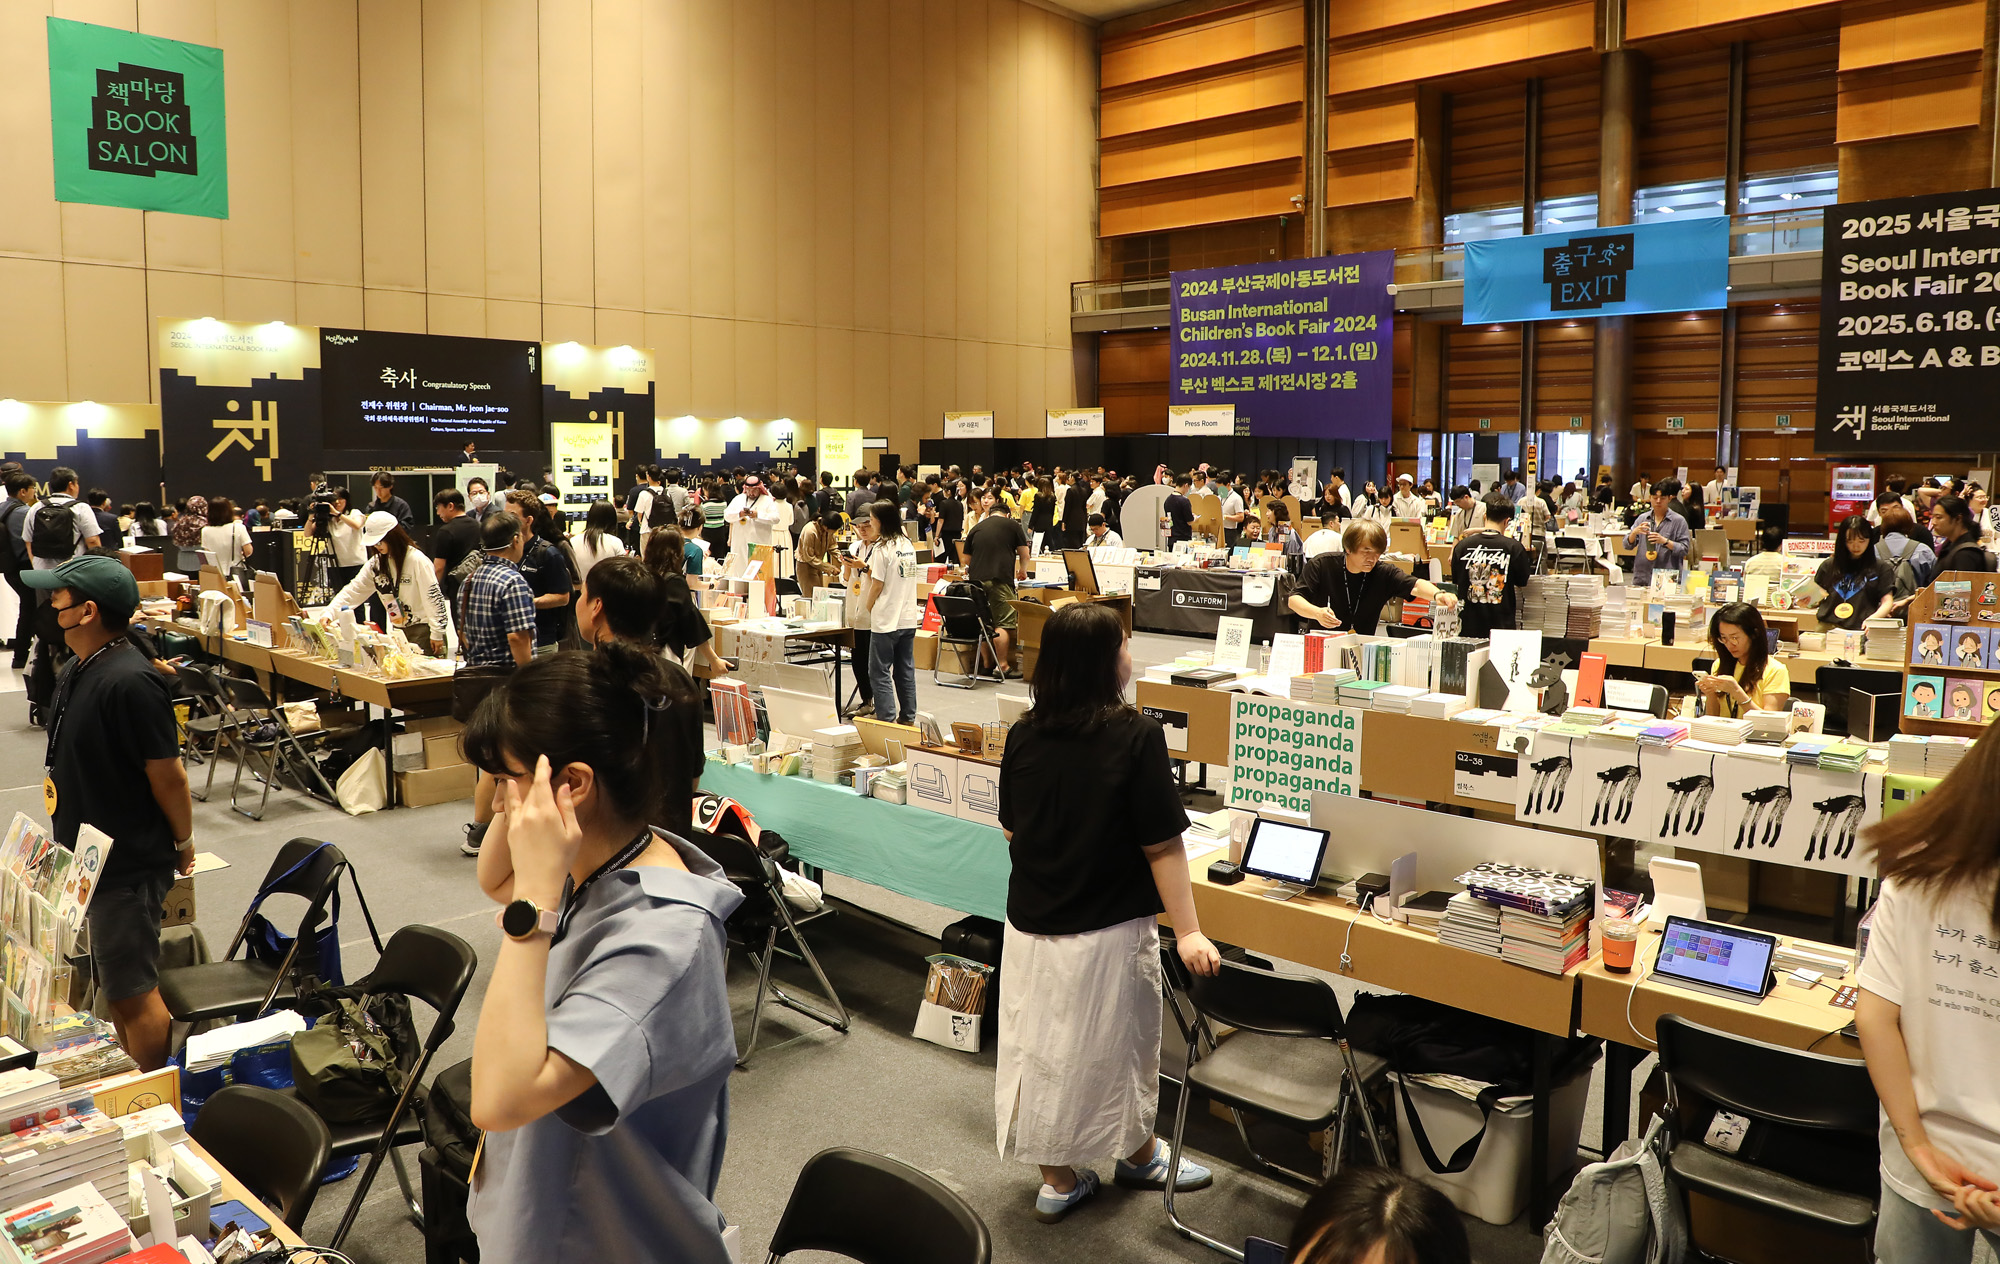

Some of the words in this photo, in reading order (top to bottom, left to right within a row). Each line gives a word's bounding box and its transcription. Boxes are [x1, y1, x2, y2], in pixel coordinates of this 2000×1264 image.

[107, 78, 176, 106] 책마당
[106, 110, 180, 134] BOOK
[98, 141, 188, 166] SALON
[1841, 214, 1911, 239] 2025
[1552, 244, 1596, 276] 출구
[1840, 249, 1916, 274] Seoul
[1180, 280, 1218, 297] 2024
[1221, 264, 1360, 295] 부산국제아동도서전
[1560, 274, 1618, 303] EXIT
[1839, 278, 1908, 301] Book
[1914, 274, 1969, 297] Fair
[1180, 307, 1224, 322] Busan
[1228, 297, 1328, 320] International
[1180, 322, 1253, 342] Children's
[1255, 321, 1296, 338] Book
[1299, 318, 1330, 335] Fair
[1333, 314, 1378, 333] 2024
[1312, 341, 1378, 362] 12.1.(일)
[1836, 348, 1914, 372] 코엑스
[1919, 348, 1943, 369] A
[1948, 346, 1974, 367] &
[1980, 345, 2000, 367] B
[380, 367, 418, 389] 축사
[422, 380, 468, 390] Congratulatory
[470, 381, 491, 390] Speech
[1180, 377, 1208, 394] 부산
[1211, 375, 1255, 393] 벡스코
[1258, 372, 1328, 392] 제1전시장
[1331, 370, 1358, 390] 2홀
[361, 400, 383, 410] 전재수
[385, 401, 408, 410] 위원장
[419, 402, 454, 412] Chairman,
[455, 404, 468, 412] Mr.
[469, 404, 483, 413] Jeon
[485, 405, 509, 414] Jae-soo
[1872, 404, 1936, 413] 서울국제도서전
[1871, 415, 1895, 423] Seoul
[1896, 414, 1950, 422] International
[1188, 596, 1222, 605] PLATFORM
[1143, 708, 1163, 719] Q2-39
[1236, 701, 1355, 731] propaganda
[1235, 721, 1354, 753] propaganda
[1234, 742, 1353, 776] propaganda
[1457, 753, 1483, 766] Q2-38
[1233, 764, 1352, 796] propaganda
[1935, 924, 1966, 943] 누가
[1932, 950, 1963, 968] 누가
[1936, 983, 1955, 994] Who
[1957, 990, 1974, 998] will
[1976, 993, 1987, 1003] be
[1944, 1001, 1961, 1010] who
[1963, 1006, 1980, 1014] will
[1983, 1010, 1994, 1019] be
